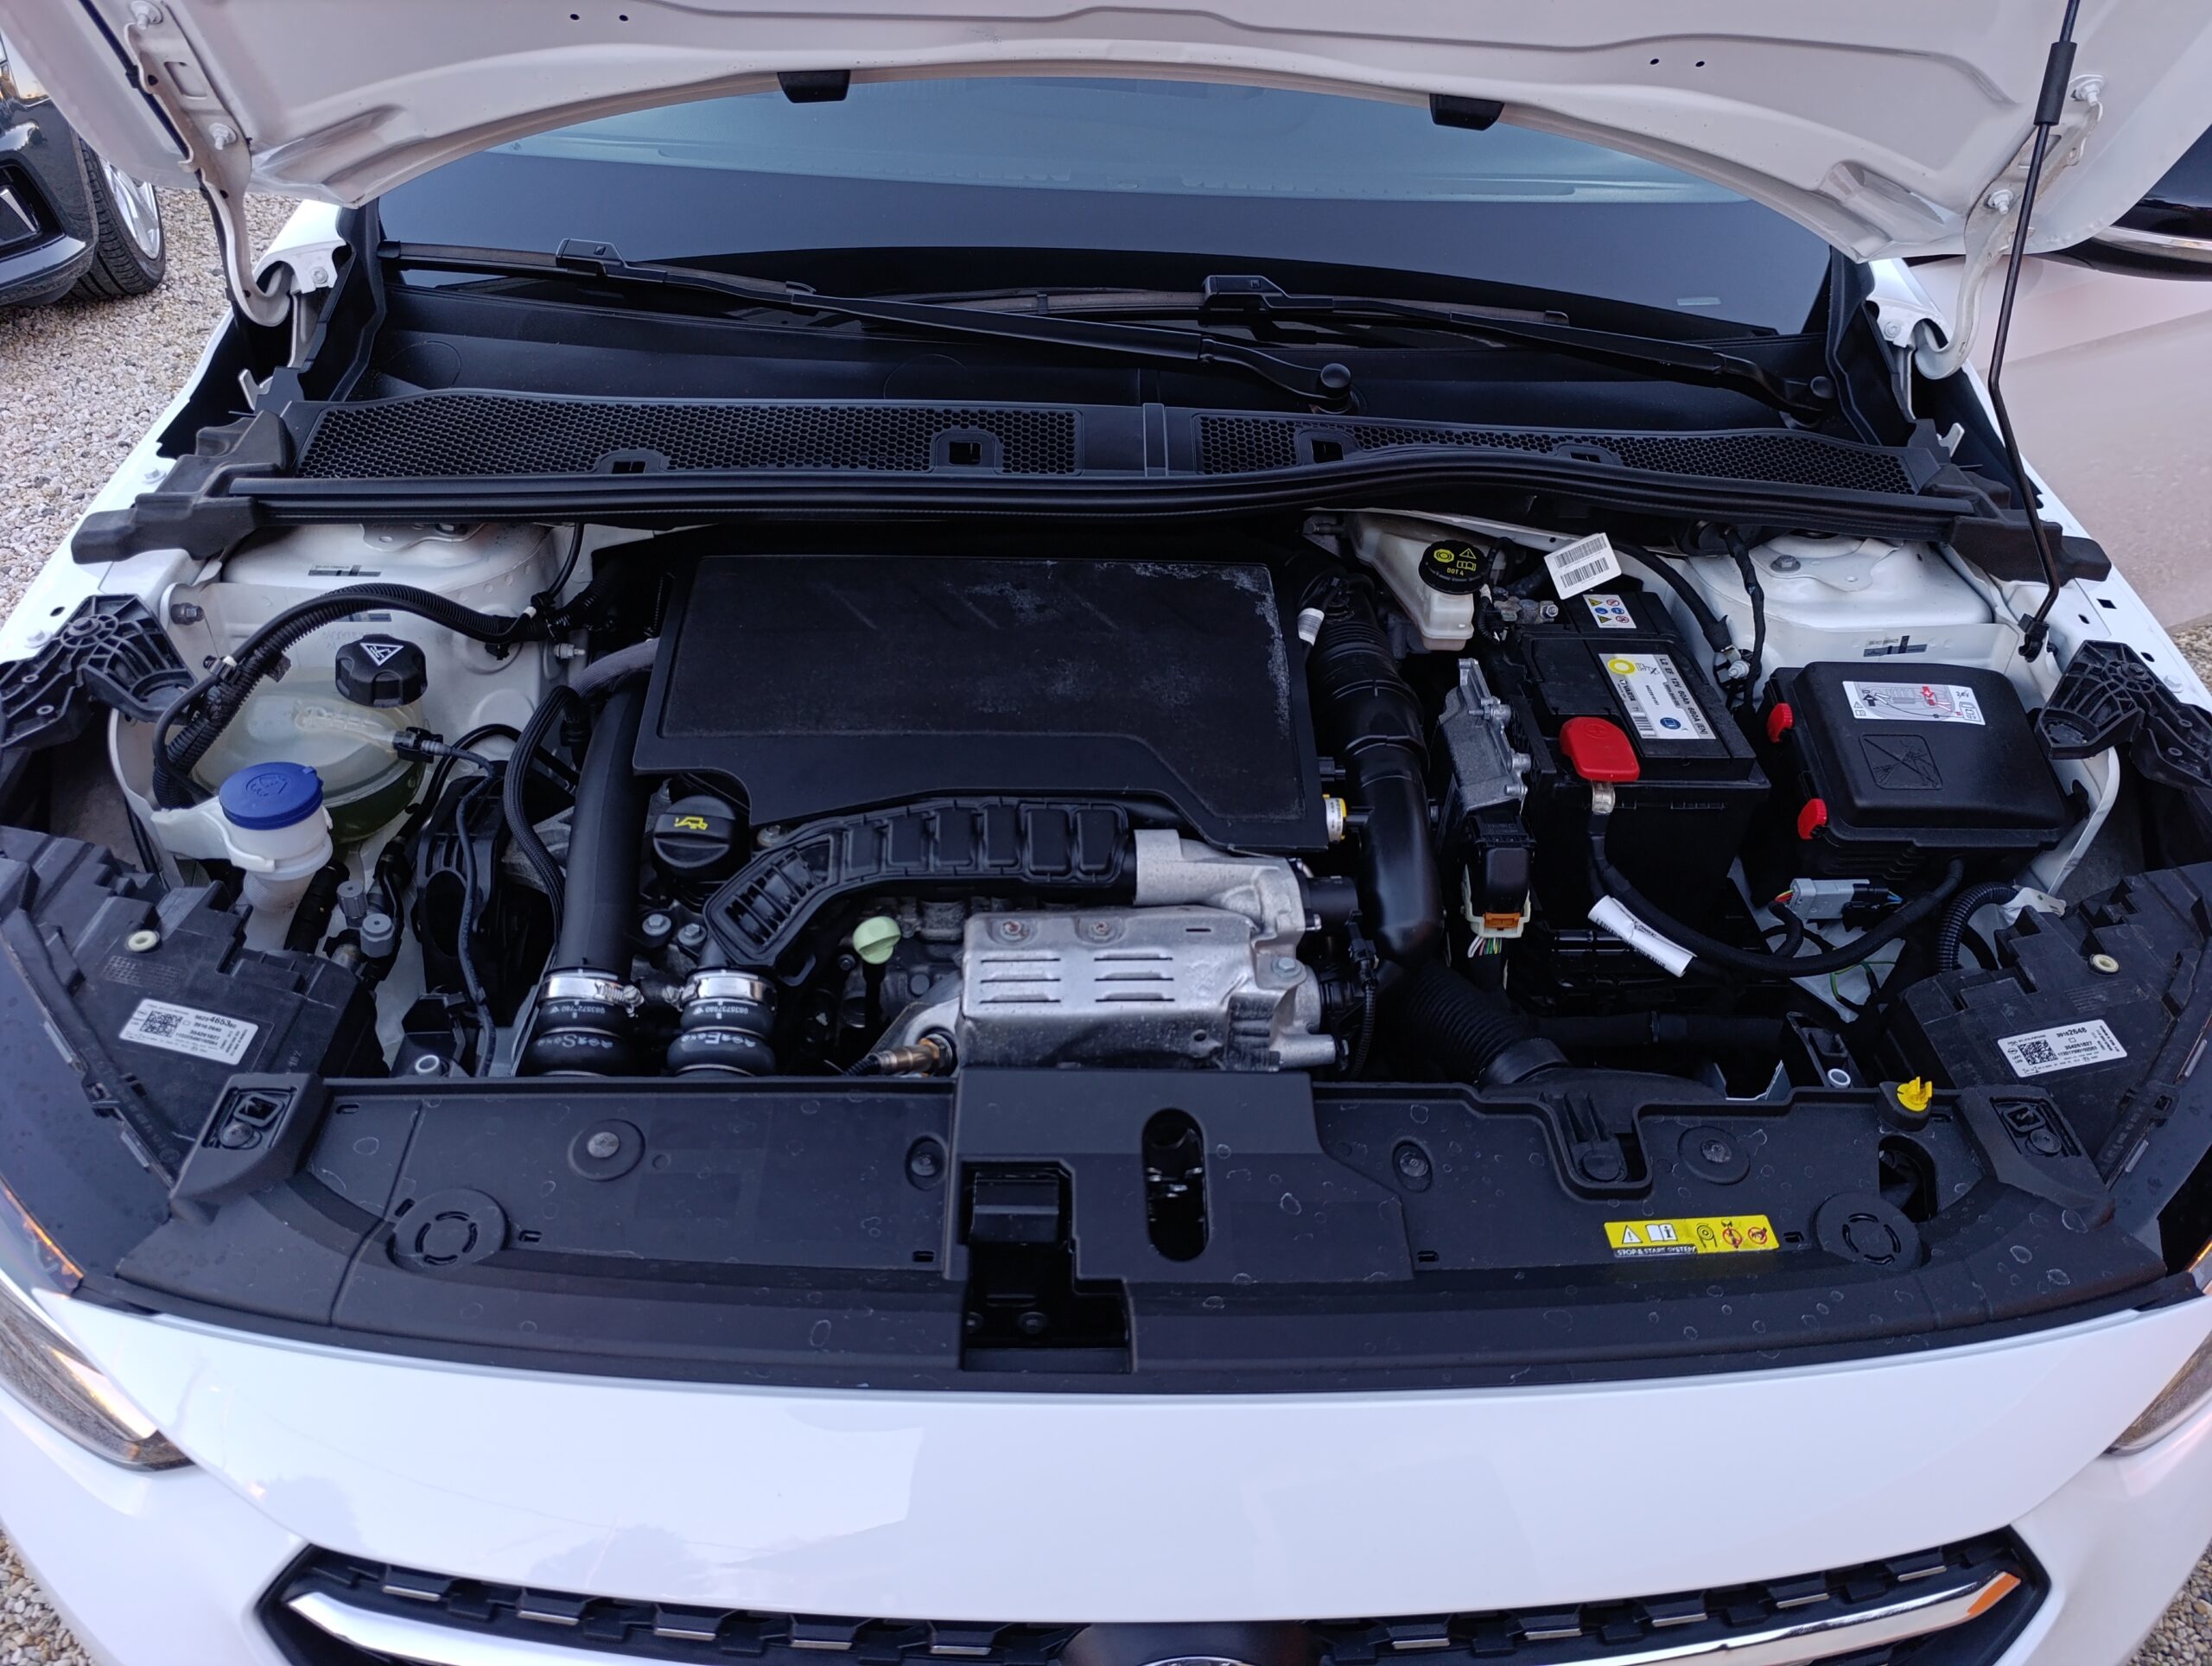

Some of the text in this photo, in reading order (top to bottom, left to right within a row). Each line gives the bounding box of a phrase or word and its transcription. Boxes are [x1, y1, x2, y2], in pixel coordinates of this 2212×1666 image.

[1624, 683, 1637, 702] VARTA
[1670, 677, 1681, 688] 12V
[1677, 690, 1691, 705] 60Ah
[1688, 707, 1700, 722] 680A
[1617, 1248, 1637, 1256] STOP
